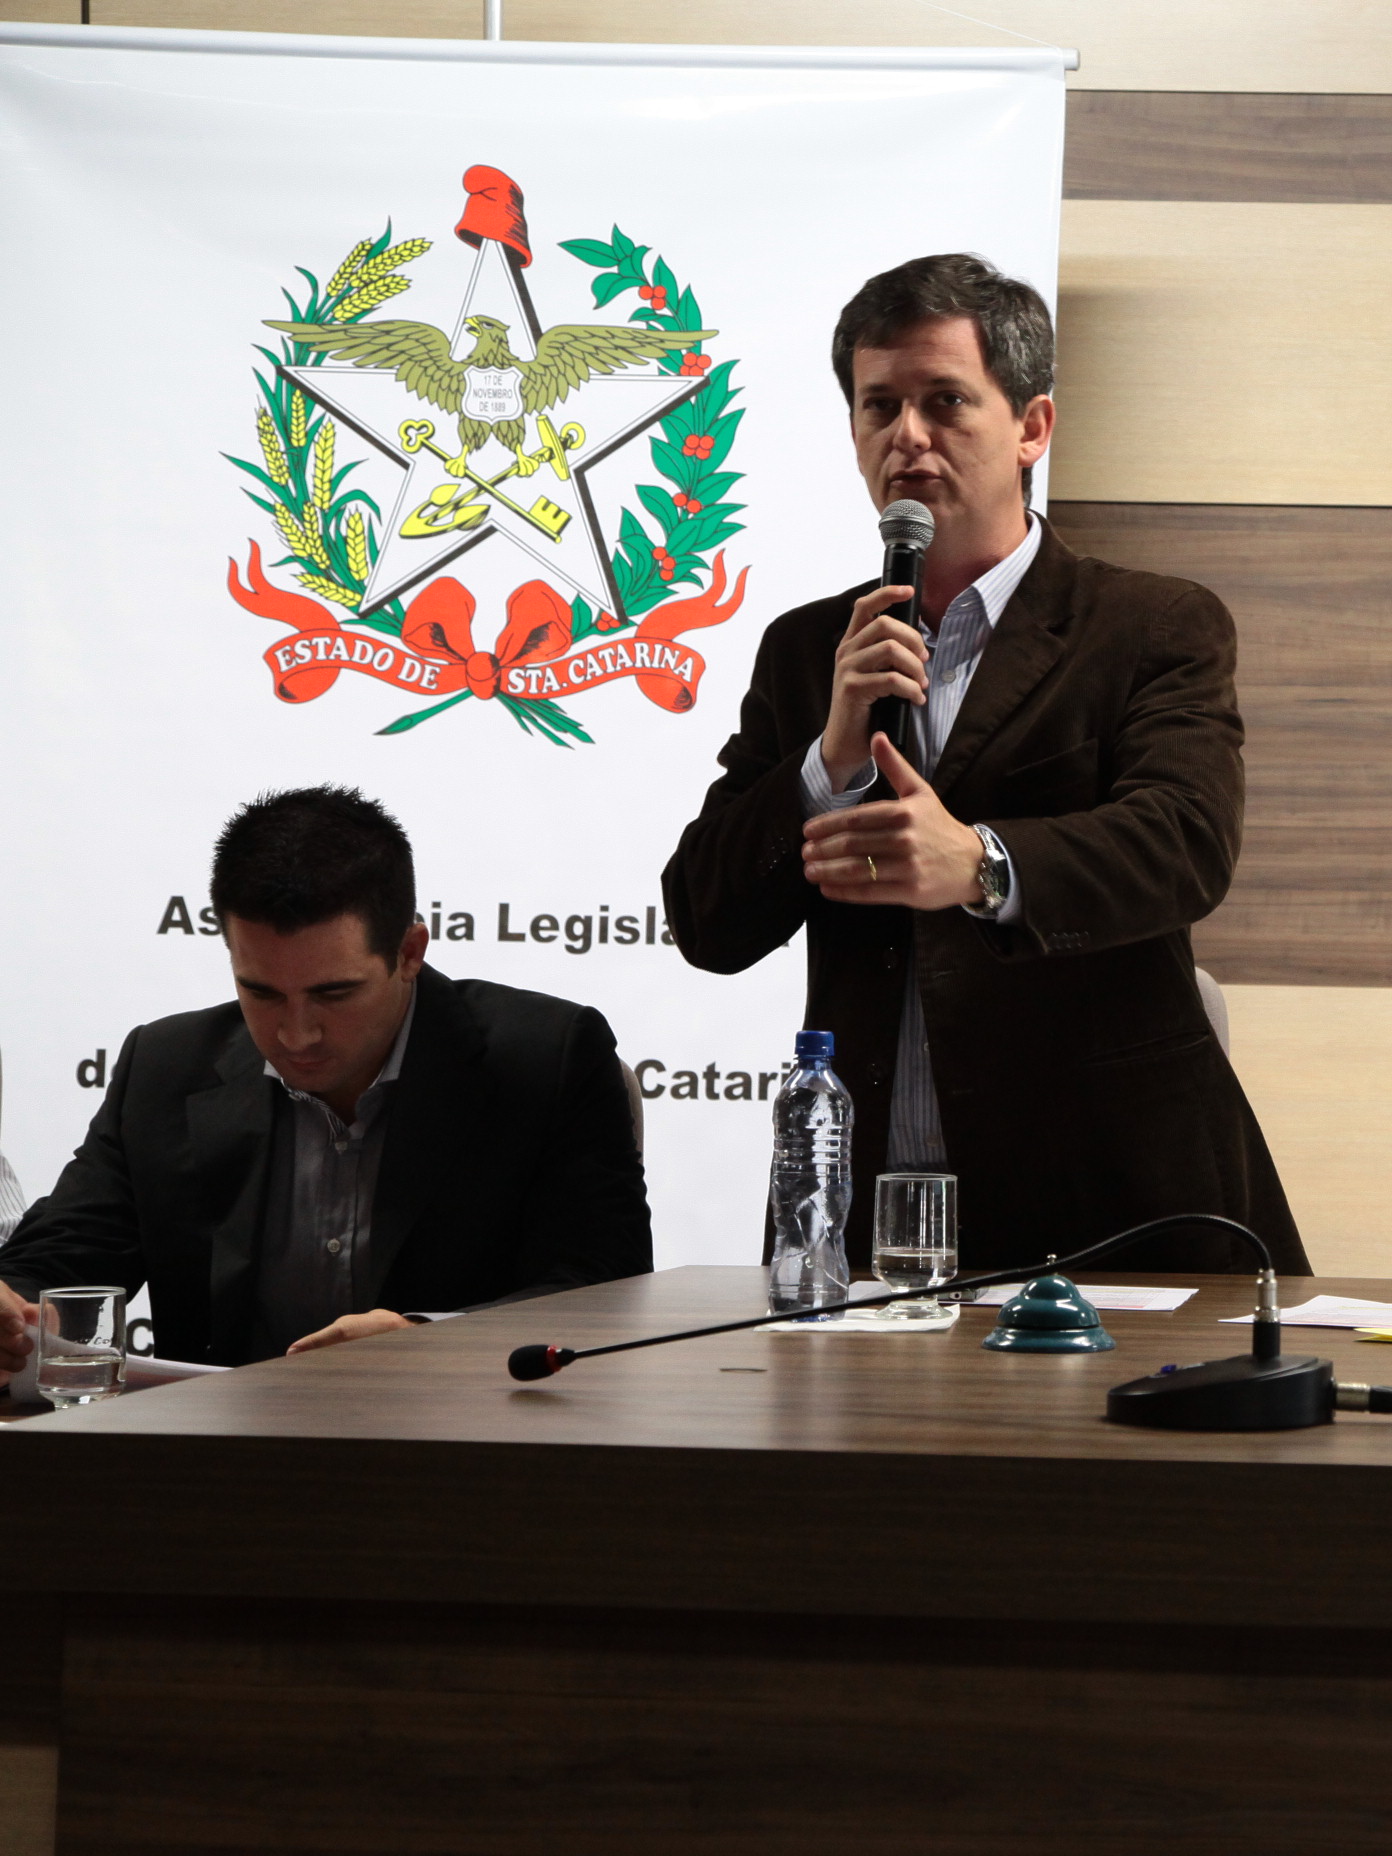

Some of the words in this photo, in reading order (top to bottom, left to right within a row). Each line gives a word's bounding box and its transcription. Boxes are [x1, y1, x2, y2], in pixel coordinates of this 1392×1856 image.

[472, 388, 513, 399] NOVEMBRO
[493, 375, 503, 386] DE
[479, 401, 489, 412] DE
[275, 638, 395, 672] ESTADO
[398, 661, 441, 690] DE
[507, 666, 568, 695] STA.
[568, 643, 695, 685] CATARINA
[497, 903, 678, 955] Legisl
[634, 1058, 796, 1101] Catari
